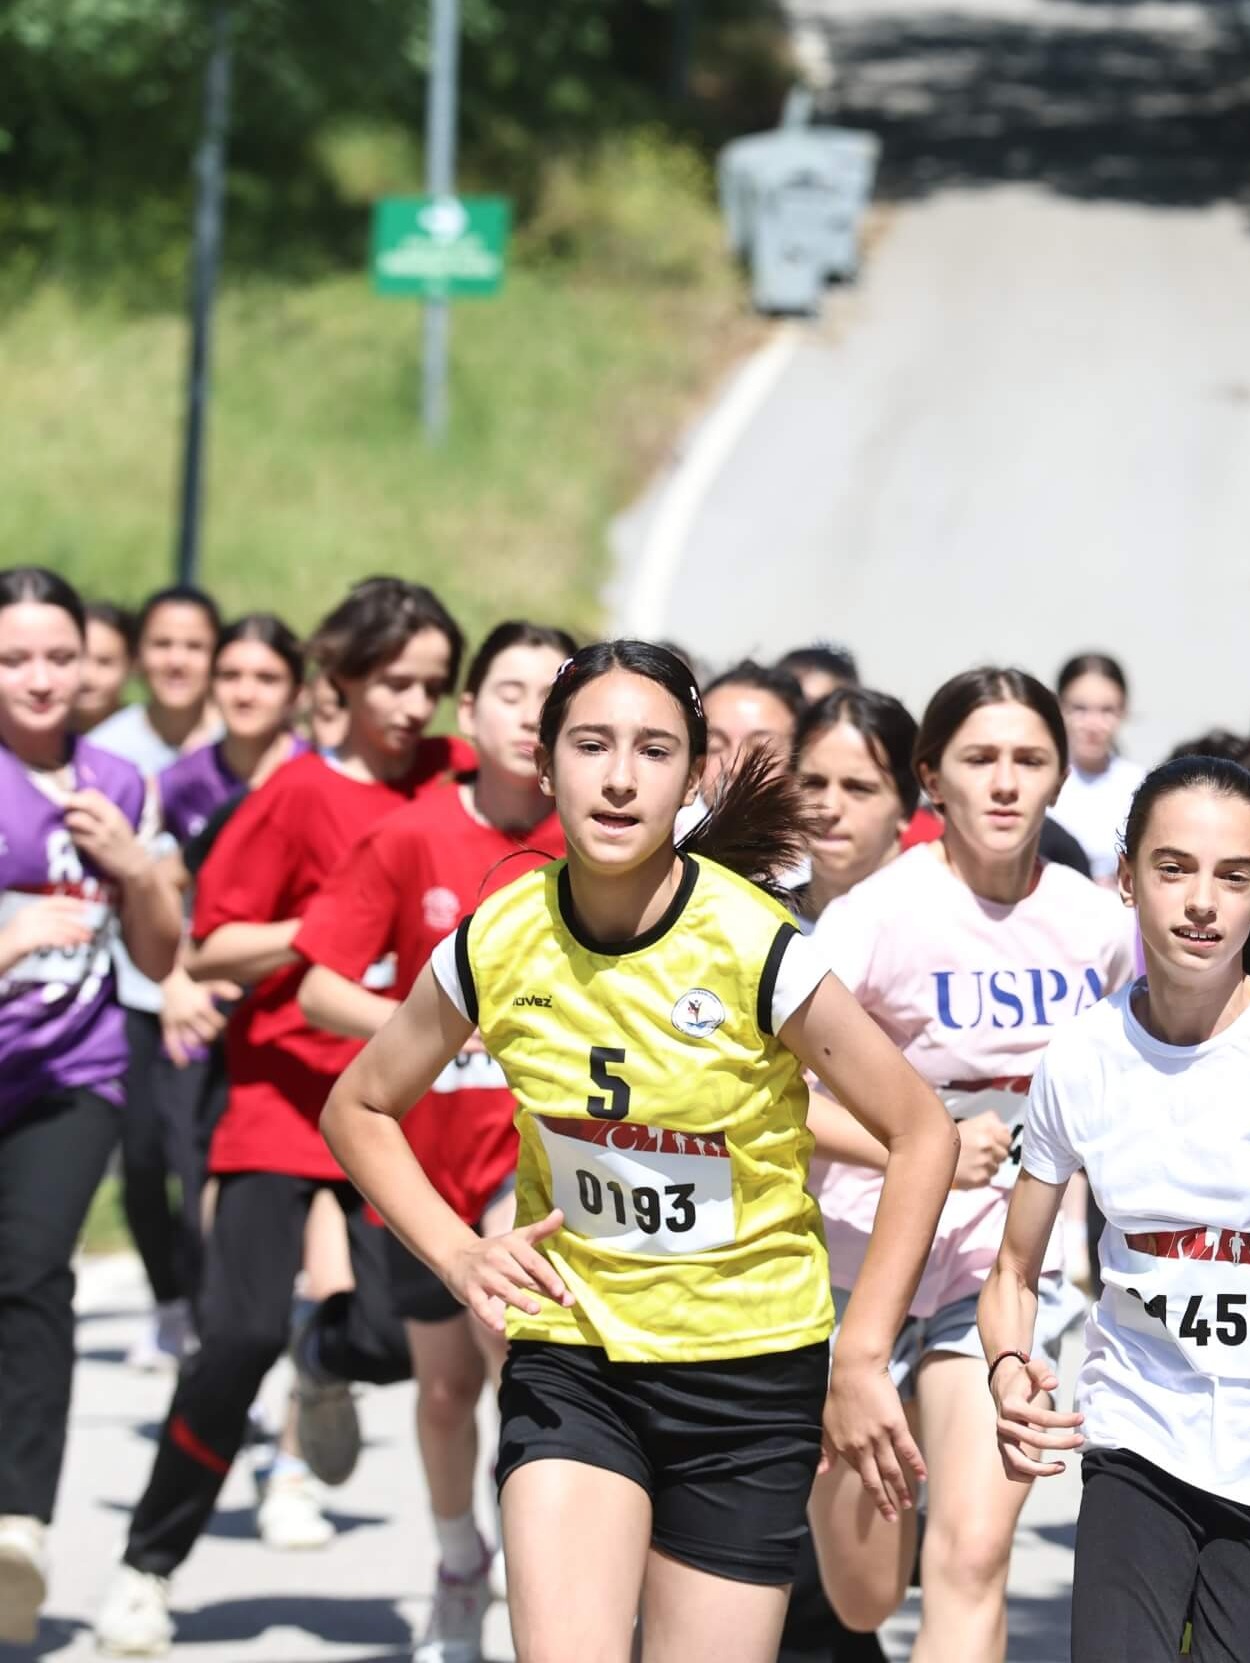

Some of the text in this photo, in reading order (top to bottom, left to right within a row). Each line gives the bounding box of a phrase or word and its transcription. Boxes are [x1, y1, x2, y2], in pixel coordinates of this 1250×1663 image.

[931, 967, 1106, 1029] USPA
[586, 1046, 631, 1121] 5
[575, 1169, 696, 1235] 0193
